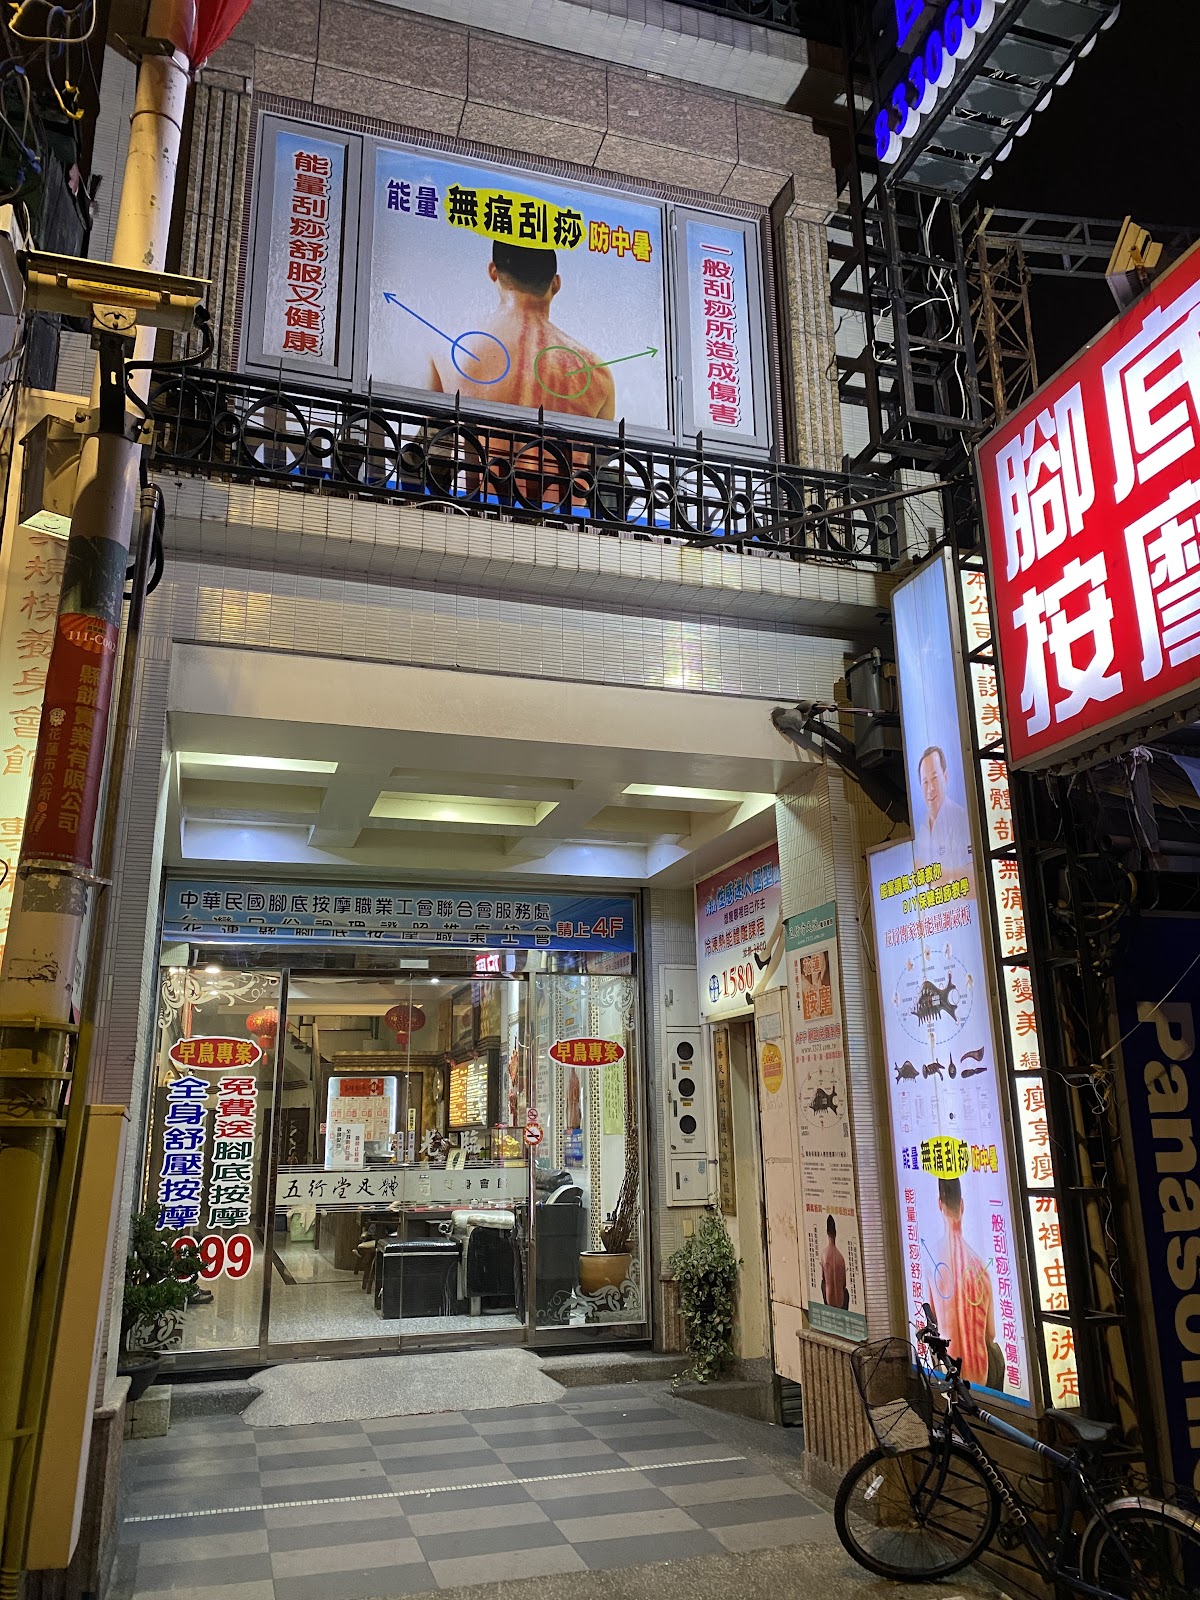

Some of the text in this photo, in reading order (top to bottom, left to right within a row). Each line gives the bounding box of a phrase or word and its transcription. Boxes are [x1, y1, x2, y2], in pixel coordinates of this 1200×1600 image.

[282, 150, 333, 356] 能量刮痧舒服又健康
[386, 179, 652, 263] 能量 無痛刮痧 防中暑
[700, 243, 740, 428] 一般刮痧所造成傷害
[995, 279, 1200, 583] 腳底
[180, 890, 552, 922] 中華民國腳底按摩職業工會聯合會服務處
[556, 916, 625, 940] 請上4F
[722, 962, 755, 999] 1580
[804, 985, 832, 1017] 按摩
[177, 1041, 254, 1066] 早鳥專案
[555, 1041, 620, 1063] 早鳥專案
[157, 1077, 209, 1230] 全身舒壓按摩
[207, 1076, 258, 1229] 免費送腳底按摩
[988, 1198, 1021, 1388] 一般刮痧所造成傷害
[1136, 1000, 1200, 1495] Panaso
